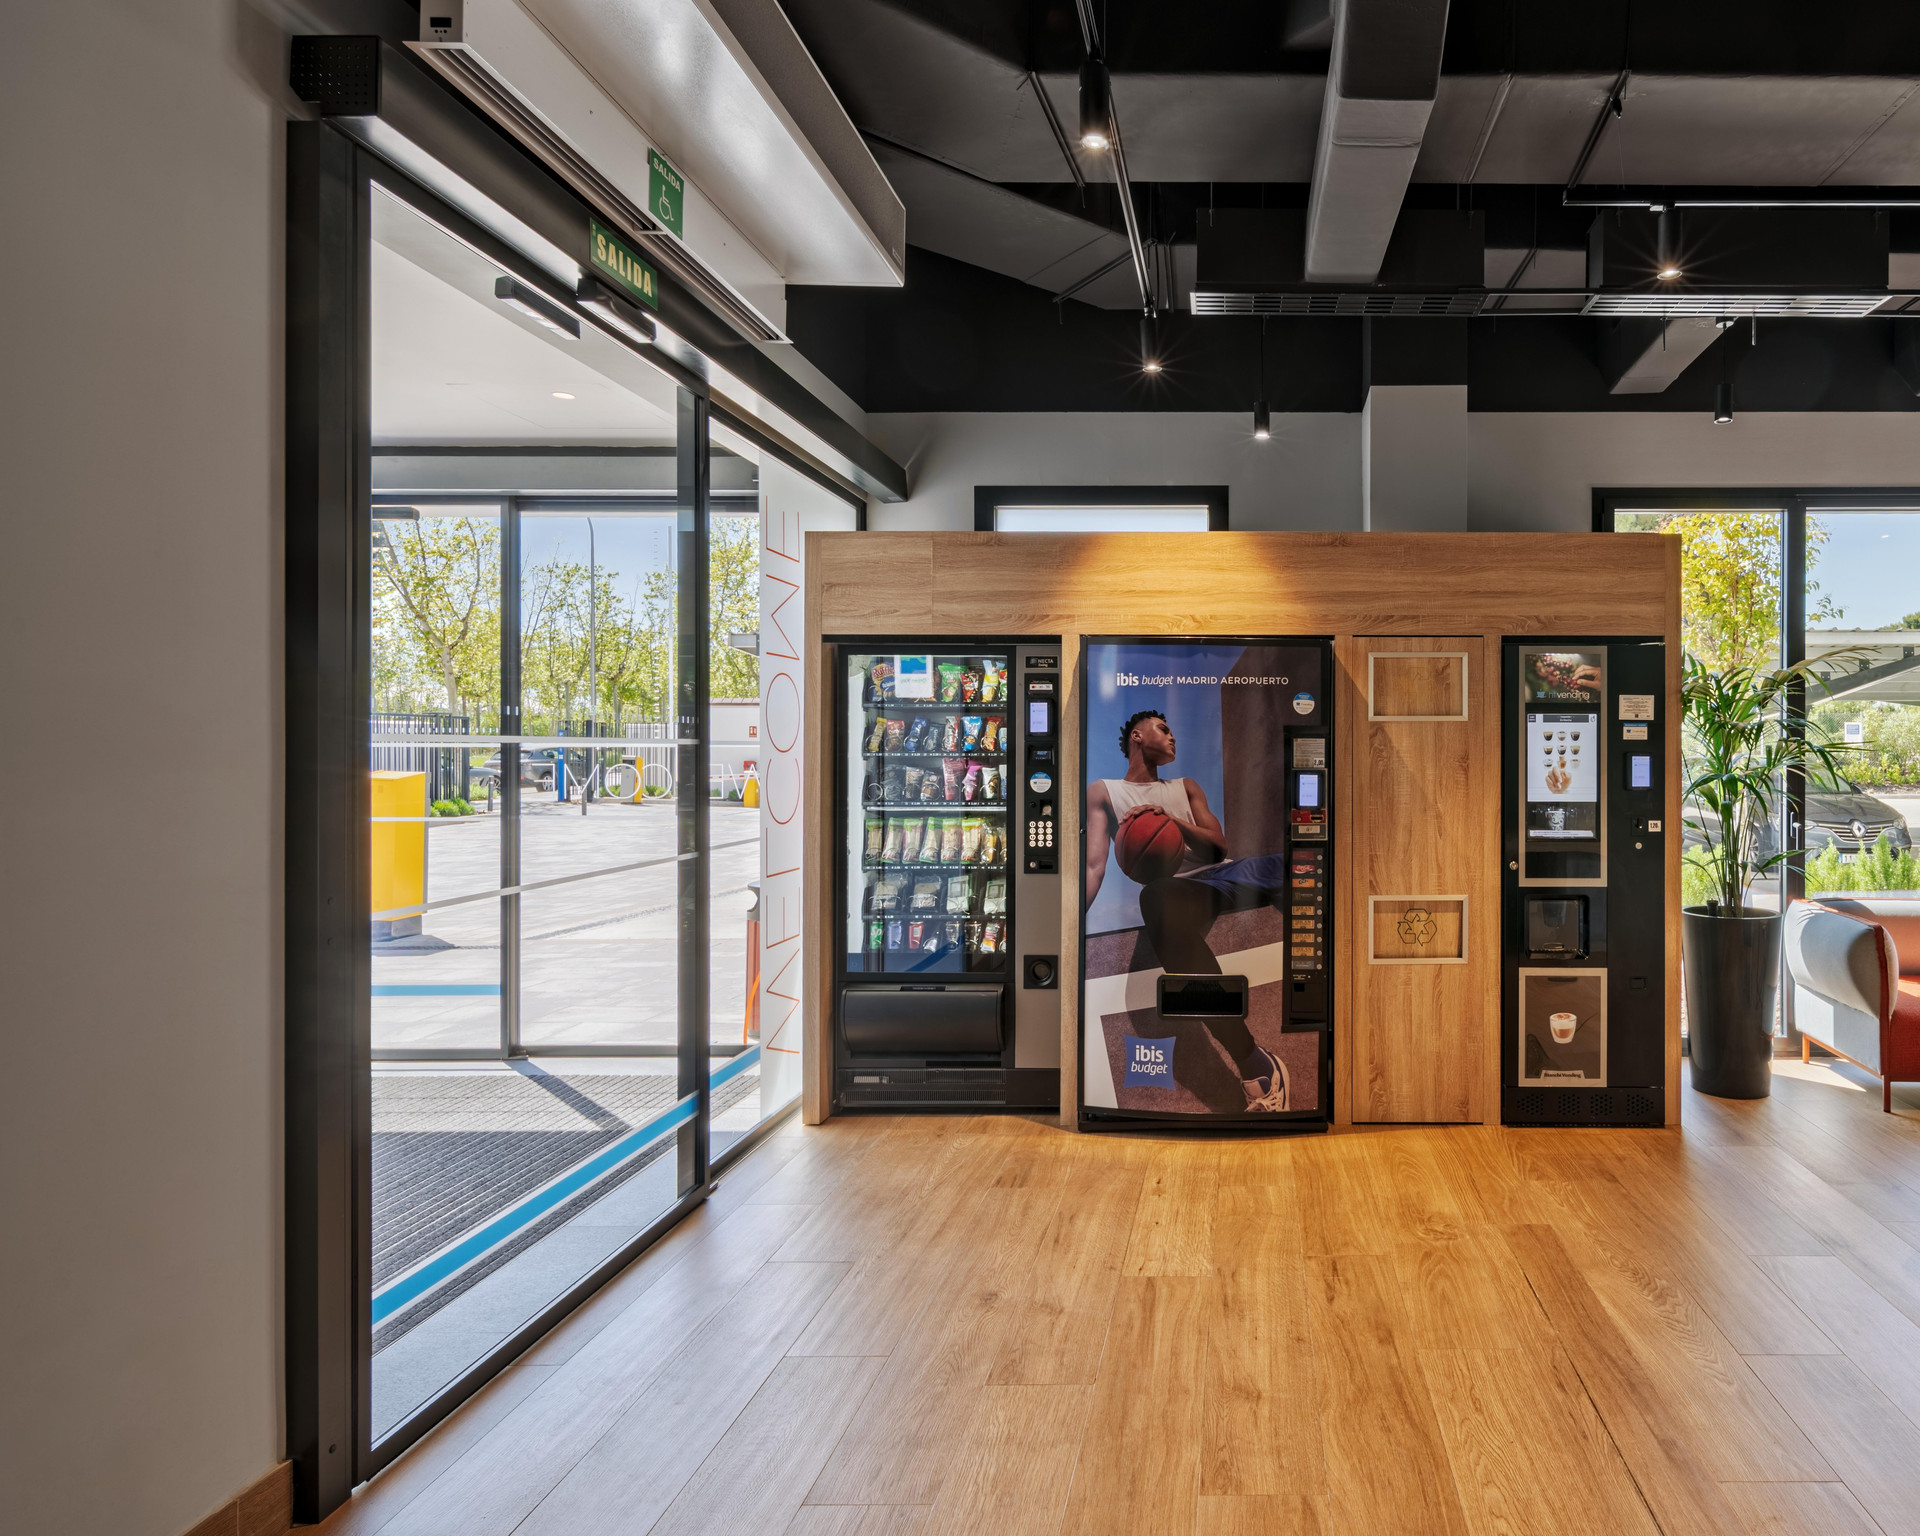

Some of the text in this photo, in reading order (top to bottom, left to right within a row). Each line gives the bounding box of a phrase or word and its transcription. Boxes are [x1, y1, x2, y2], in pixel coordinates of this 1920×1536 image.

[653, 158, 681, 192] SALIDA
[596, 233, 653, 298] SALIDA
[1116, 673, 1289, 687] ibis budget MADRID AEROPUERTO
[1135, 1045, 1164, 1062] ibis
[1130, 1061, 1168, 1076] budget
